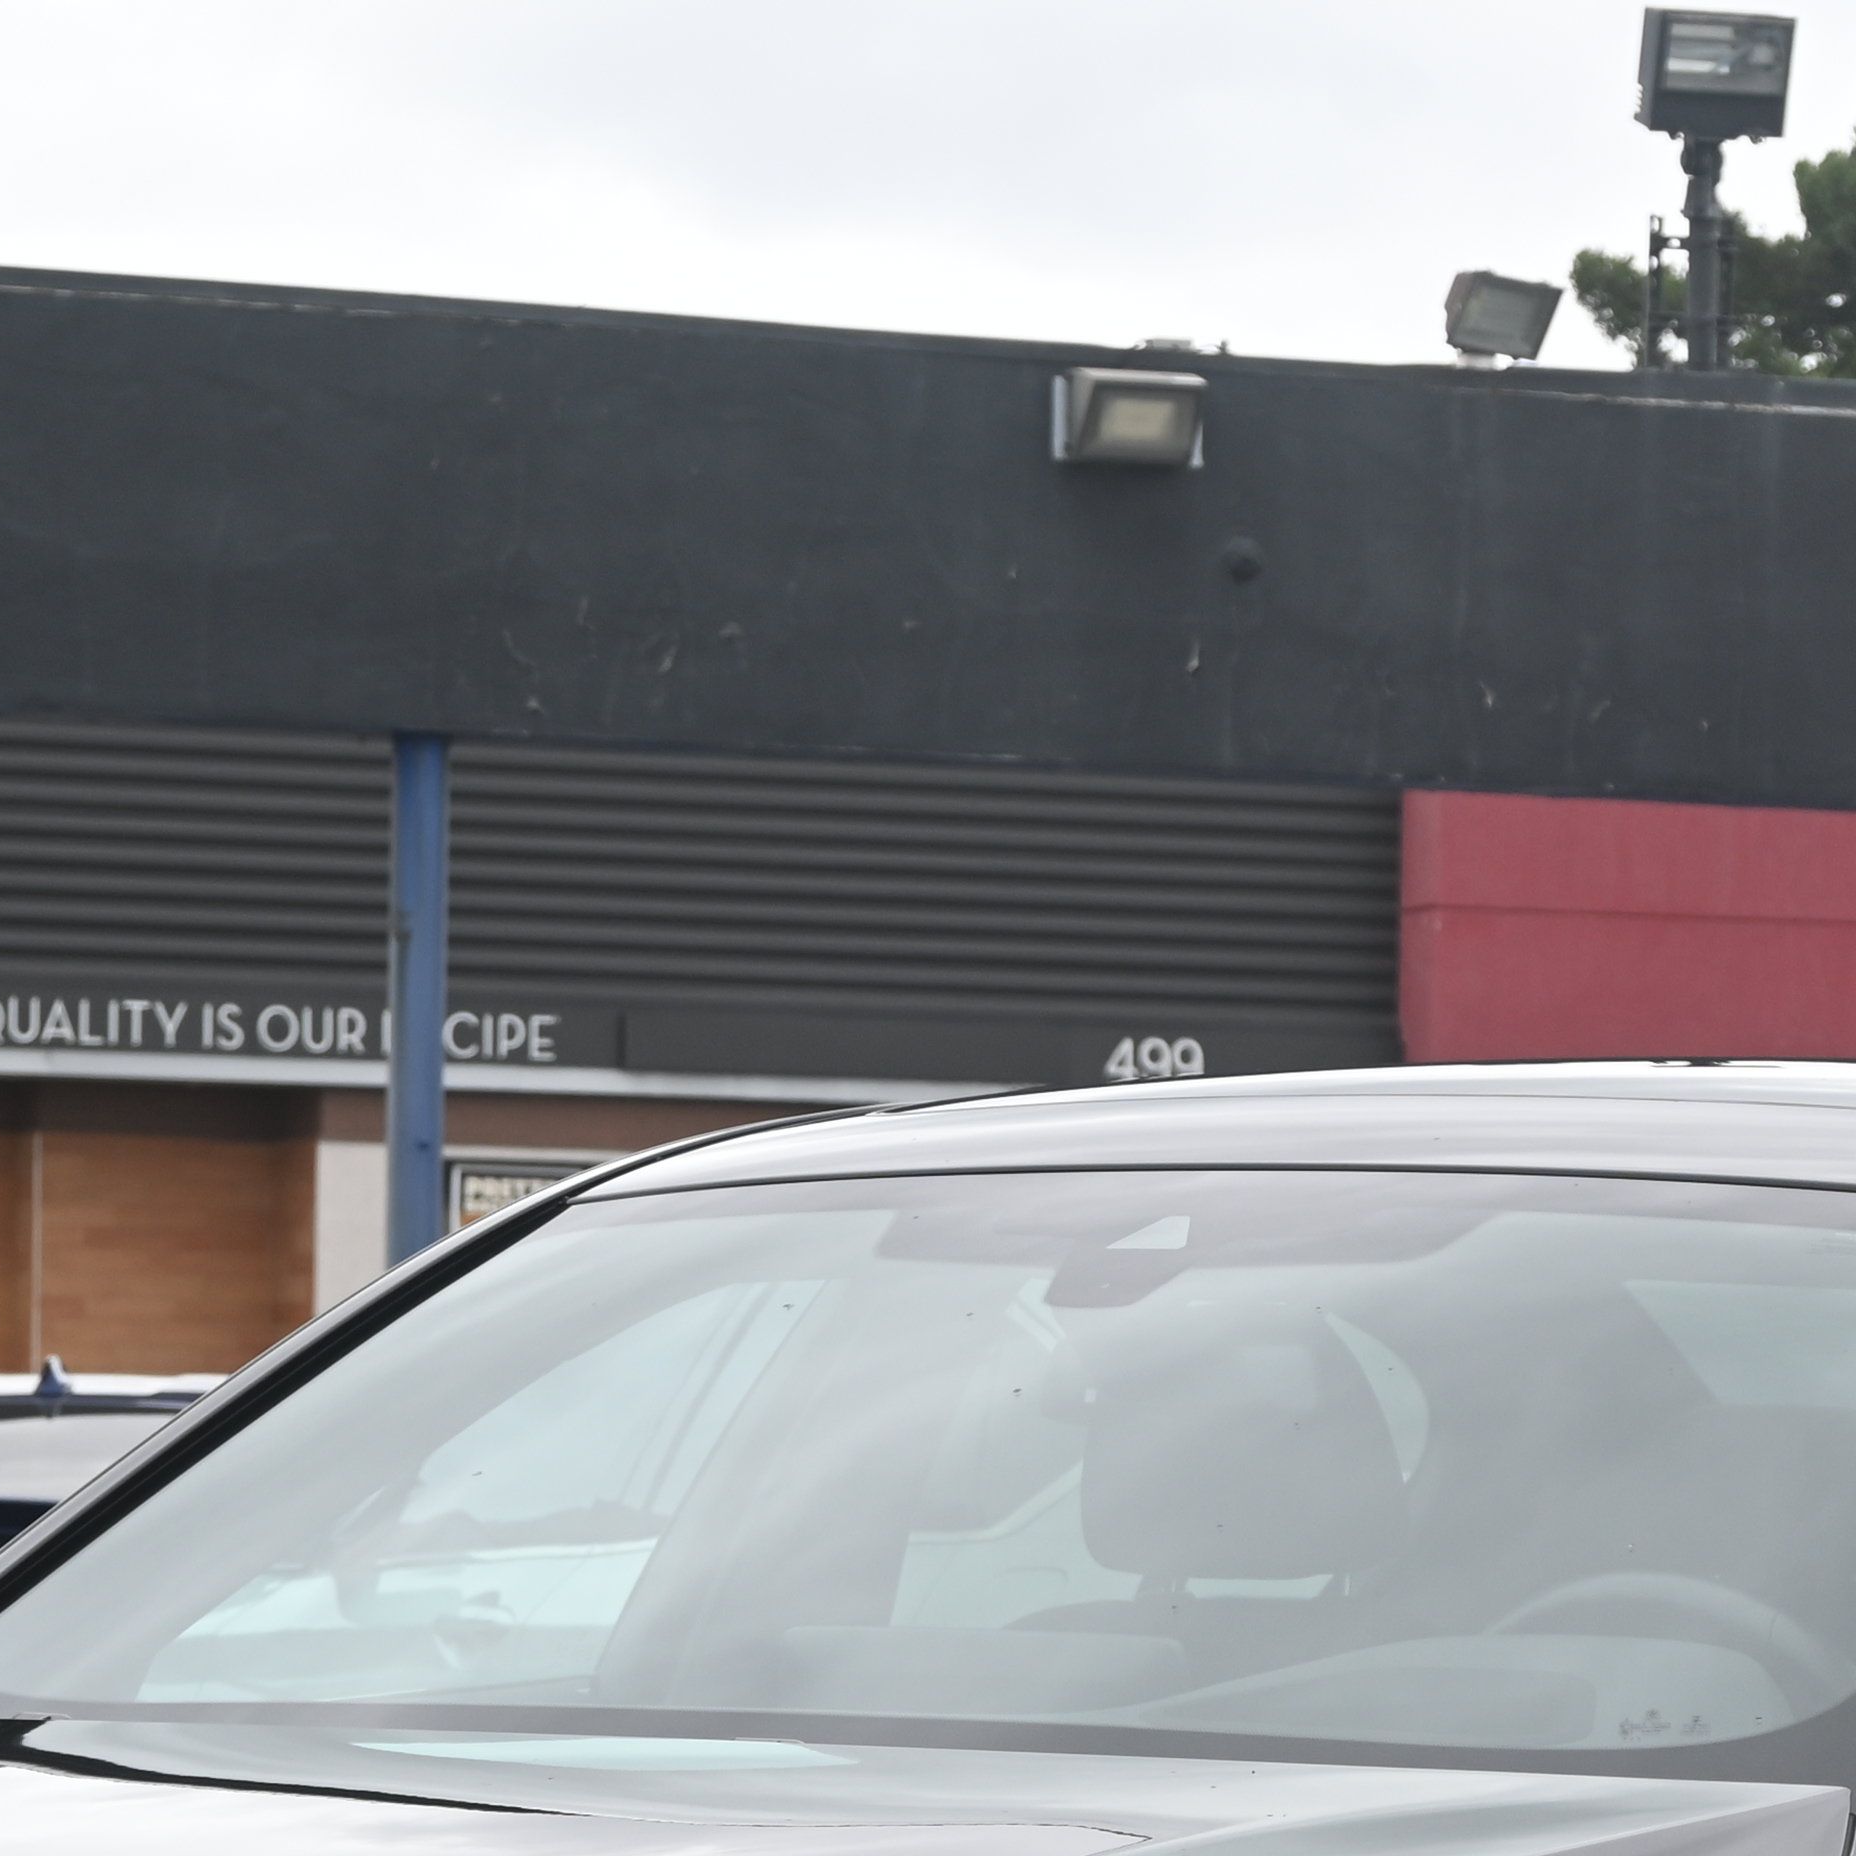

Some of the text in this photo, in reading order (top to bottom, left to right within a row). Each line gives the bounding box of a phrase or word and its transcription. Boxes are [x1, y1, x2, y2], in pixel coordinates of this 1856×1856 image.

[202, 1002, 245, 1050] IS
[256, 1004, 367, 1054] OUR
[380, 1009, 561, 1062] CIPE
[1105, 1036, 1205, 1081] 499
